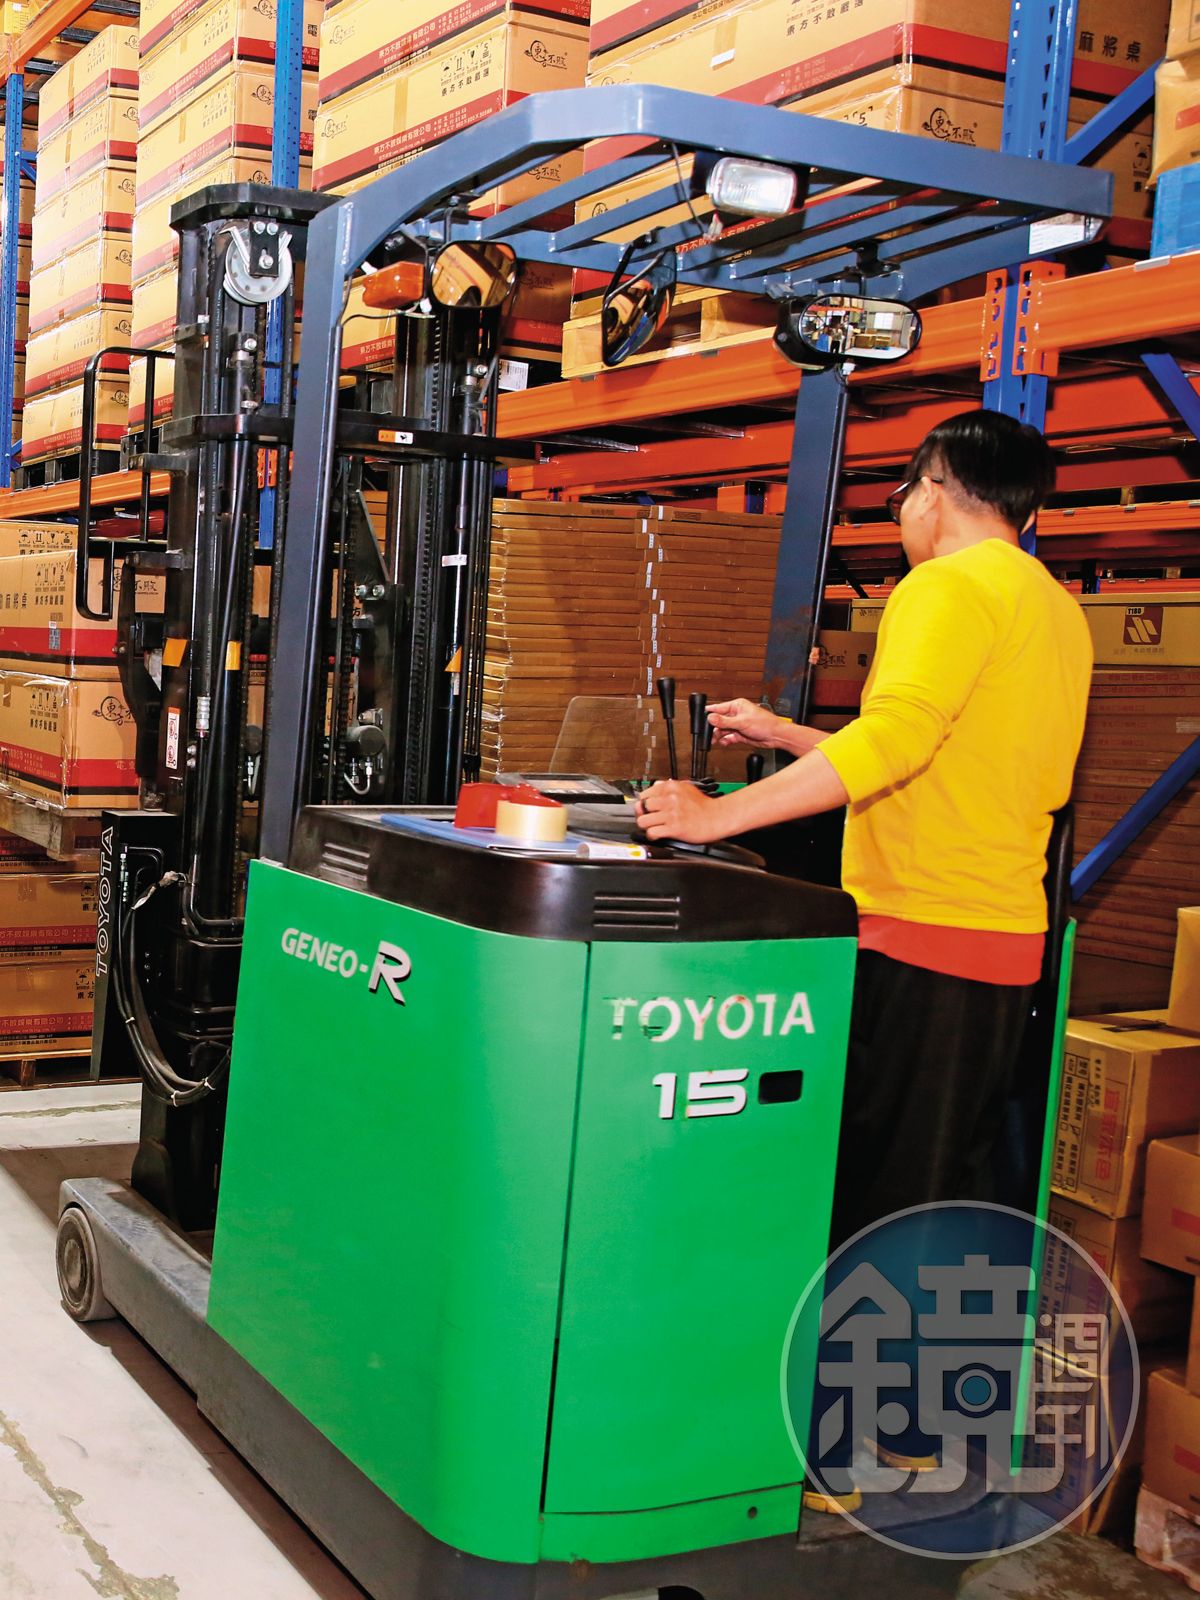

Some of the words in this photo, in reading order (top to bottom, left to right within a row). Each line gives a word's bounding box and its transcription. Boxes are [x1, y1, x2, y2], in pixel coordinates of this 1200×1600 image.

[1078, 31, 1141, 62] 麻將桌
[96, 826, 114, 978] TOYOTA
[281, 927, 412, 1006] GENEO-R
[610, 992, 816, 1042] TOYOTA
[651, 1068, 749, 1120] 15
